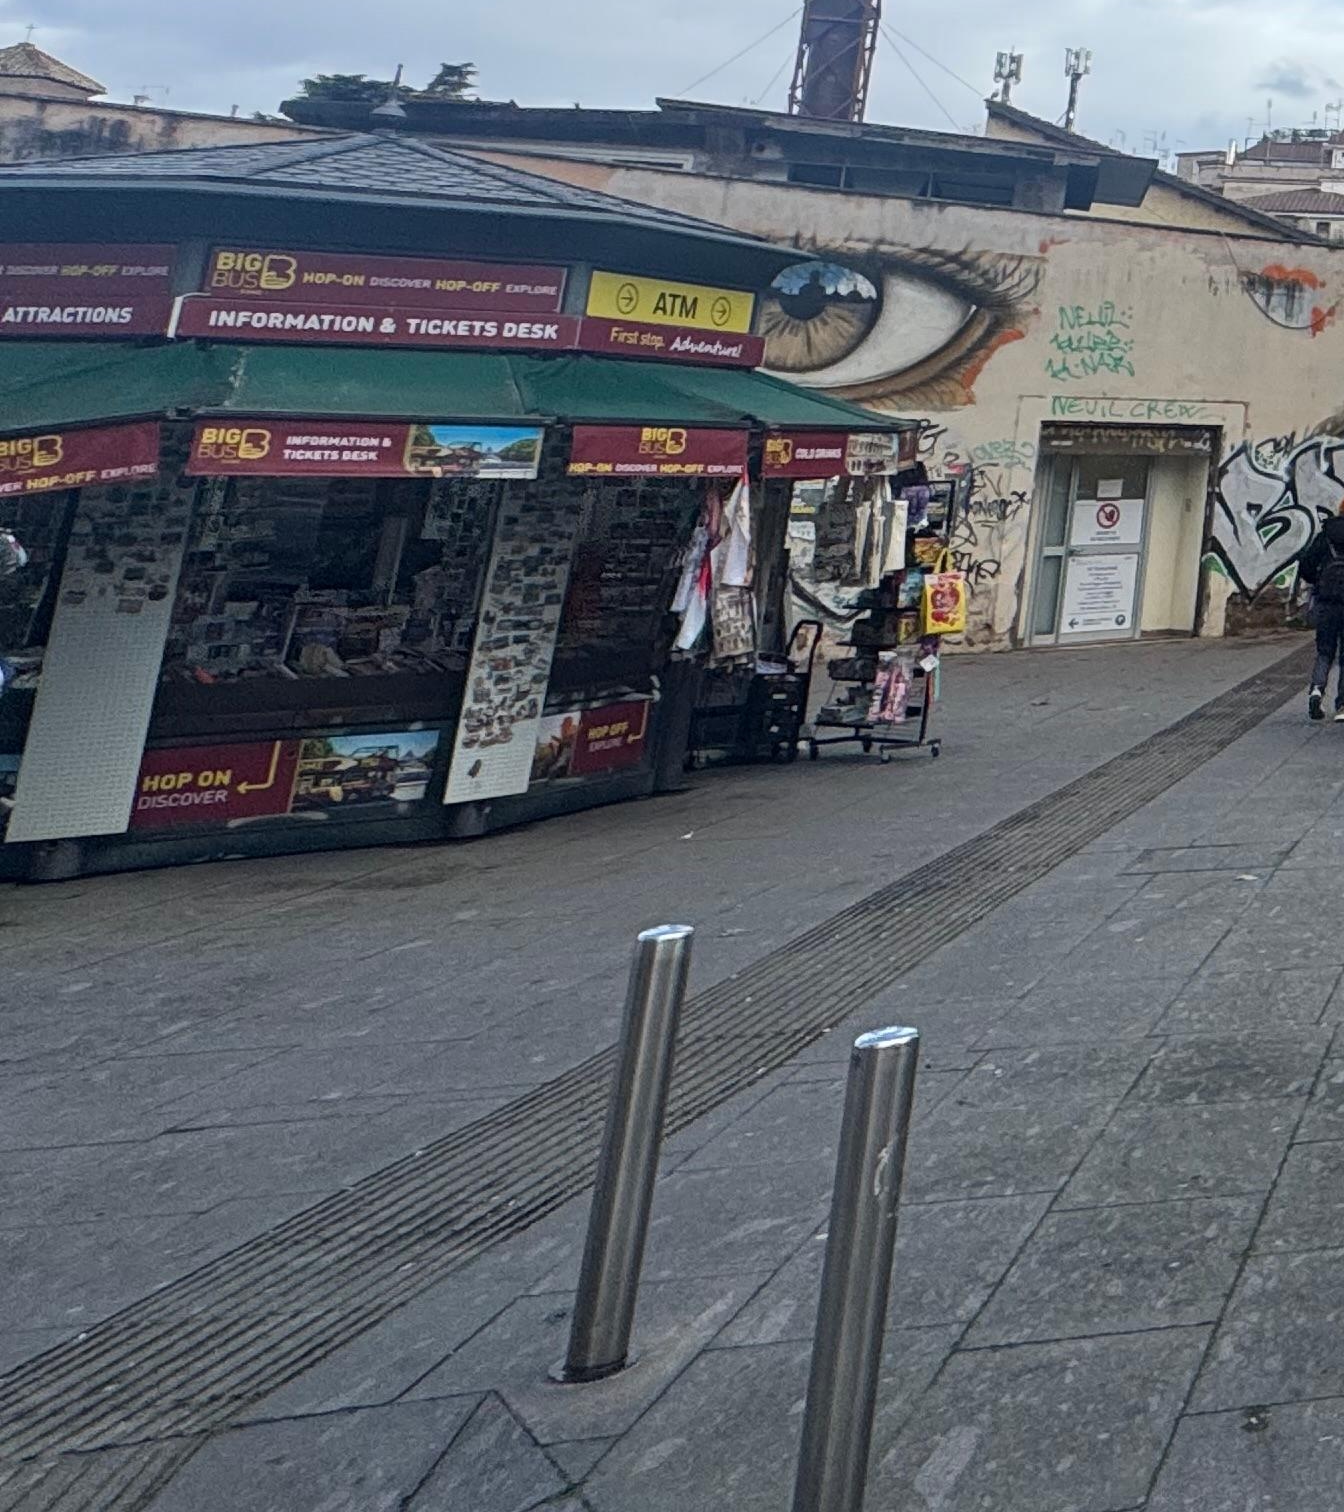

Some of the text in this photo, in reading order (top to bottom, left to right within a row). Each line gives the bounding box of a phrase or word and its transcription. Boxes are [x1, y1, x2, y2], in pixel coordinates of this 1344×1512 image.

[216, 251, 263, 272] BIG
[211, 271, 259, 288] BUS
[302, 271, 558, 296] HOP-ON DISCOVER HOP-OFF EXPLORE
[1, 306, 134, 324] ATTRACTIONS
[652, 292, 699, 320] ATM
[208, 310, 560, 340] INFORMATION & TICKETS DESK
[202, 428, 242, 444] BIG
[286, 435, 392, 448] INFORMATION &
[641, 427, 669, 442] BIG
[198, 444, 238, 459] BUS
[282, 449, 379, 462] TICKETS DESK
[638, 441, 666, 455] BUS
[26, 470, 97, 490] HOP-OFF
[100, 463, 158, 480] EXPLORE
[142, 769, 233, 792] HOP ON
[137, 789, 229, 810] DISCOVER
